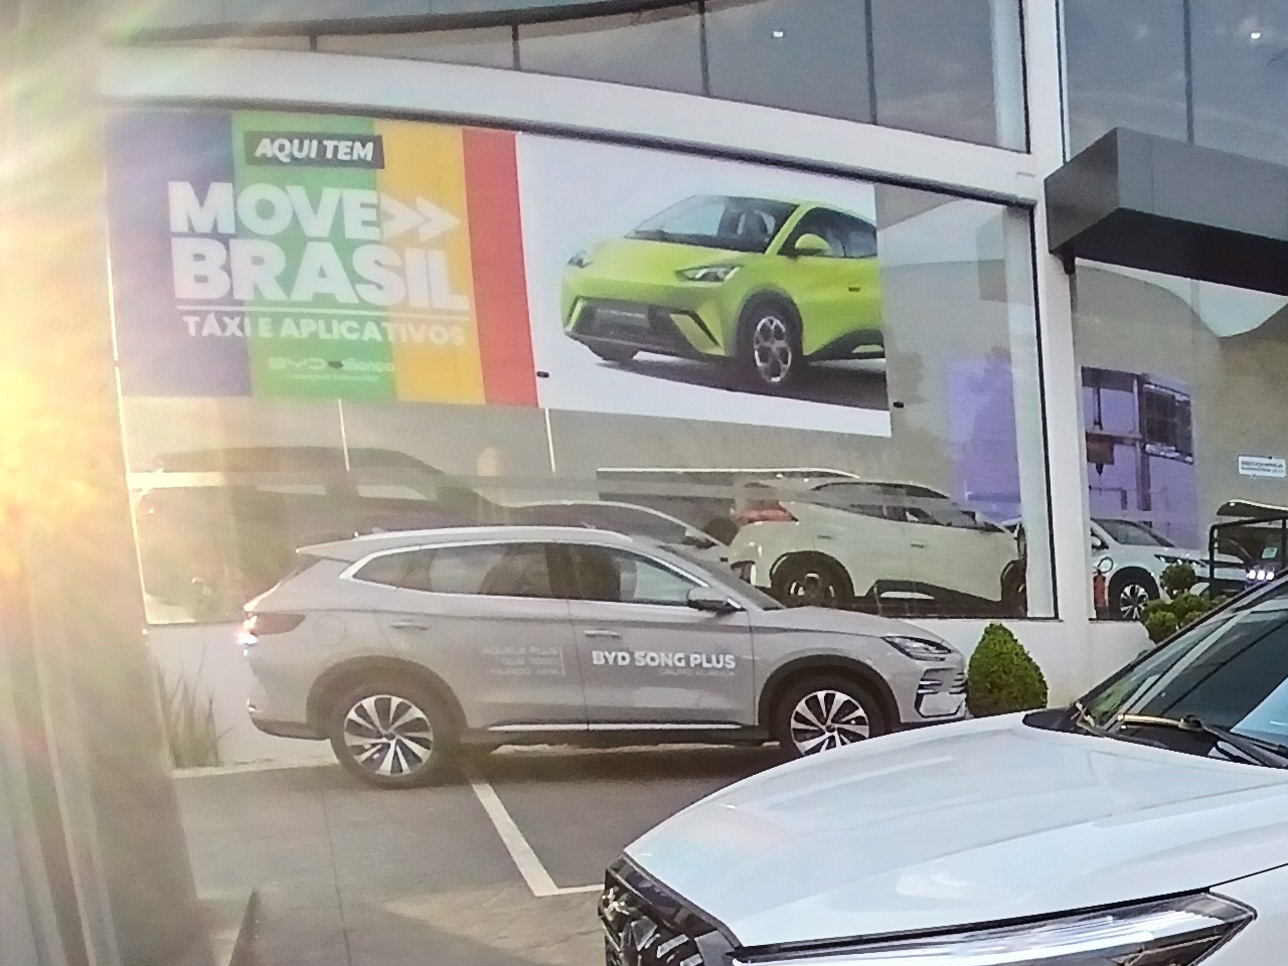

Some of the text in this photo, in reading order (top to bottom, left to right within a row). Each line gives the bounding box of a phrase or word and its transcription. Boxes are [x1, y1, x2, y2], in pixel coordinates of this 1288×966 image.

[254, 138, 374, 162] AQUI TEM
[168, 181, 380, 239] MOVE
[171, 237, 469, 311] BRASIL
[258, 317, 273, 337] E
[281, 317, 465, 346] APLICATIVOS
[592, 650, 736, 669] BYD SONG PLUS
